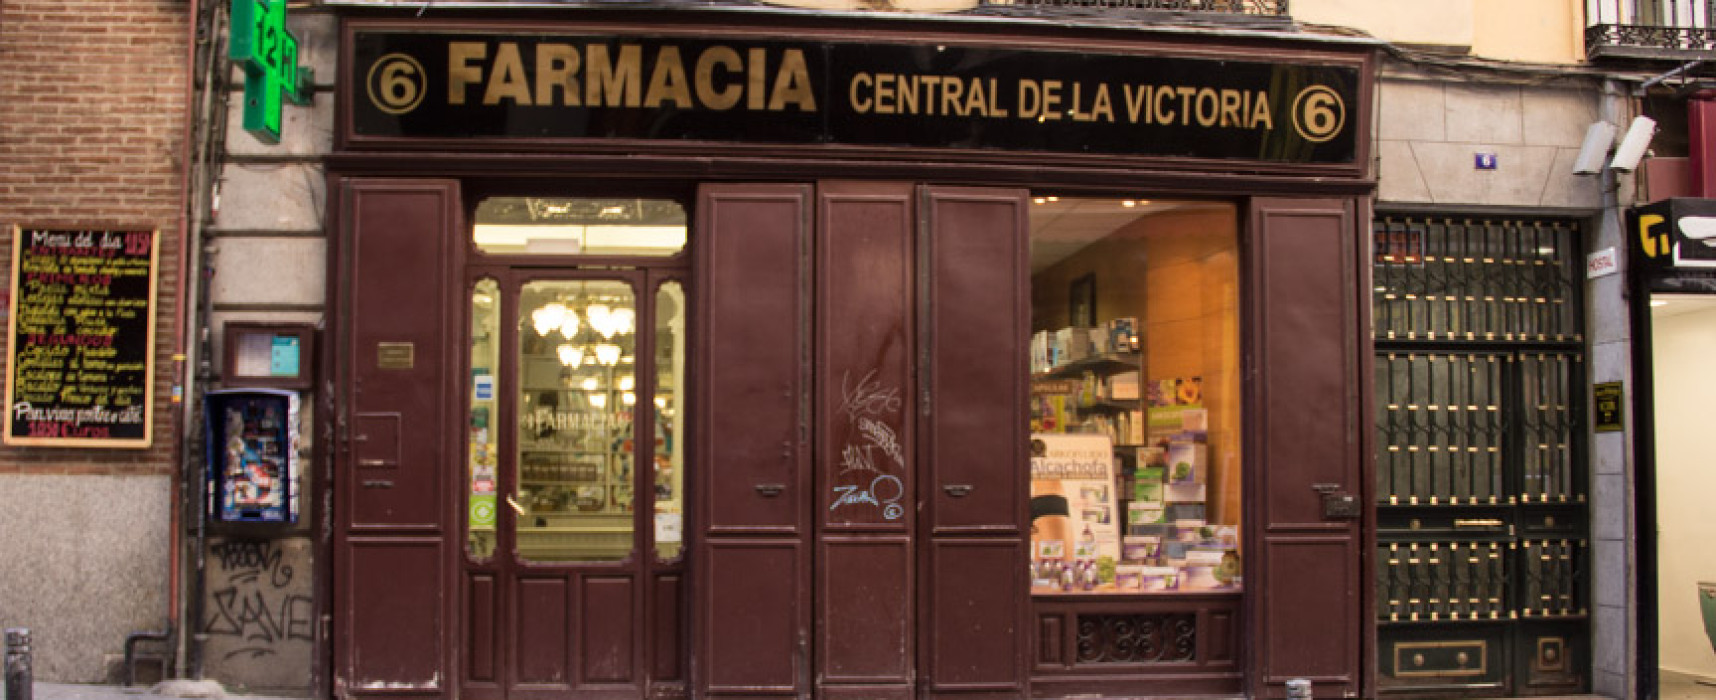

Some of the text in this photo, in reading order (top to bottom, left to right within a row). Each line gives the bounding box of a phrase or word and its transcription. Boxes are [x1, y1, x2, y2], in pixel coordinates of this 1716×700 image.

[447, 41, 818, 113] FARMACIA
[849, 72, 1274, 131] CENTRAL DE LA VICTORIA
